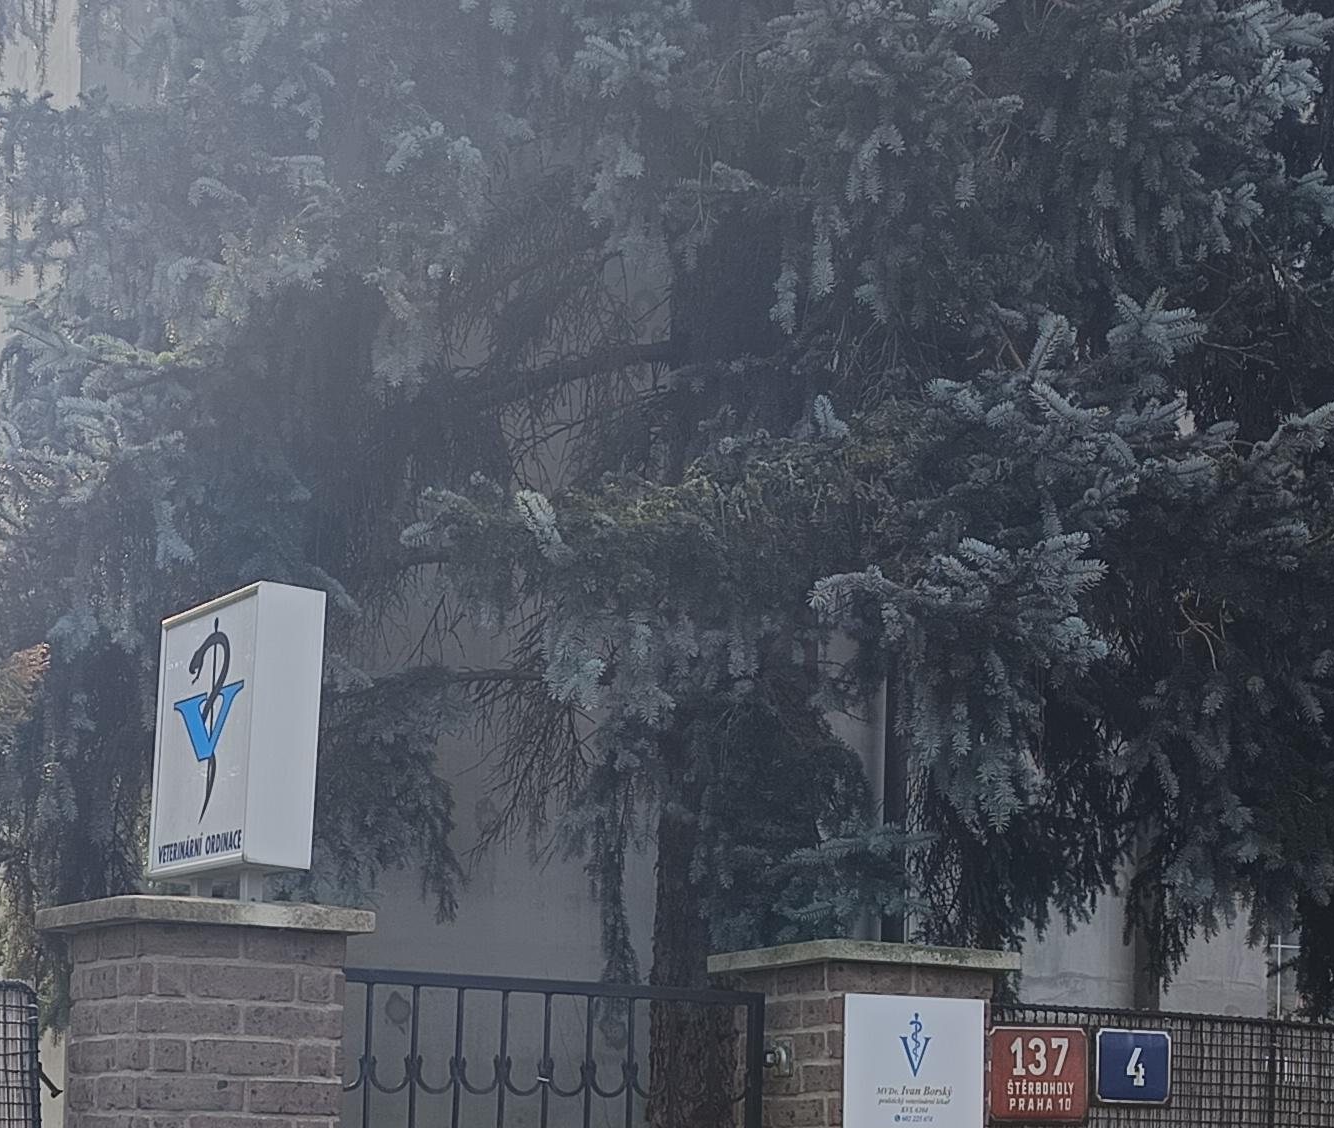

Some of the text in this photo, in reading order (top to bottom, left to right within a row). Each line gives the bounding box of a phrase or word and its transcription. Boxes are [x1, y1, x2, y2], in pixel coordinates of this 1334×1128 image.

[158, 829, 242, 864] VETERINÁRNÍ ORDINACE
[1010, 1037, 1069, 1076] 137
[1126, 1047, 1145, 1086] 4
[901, 1085, 921, 1095] Ivan
[923, 1086, 952, 1098] Borský
[1007, 1079, 1075, 1095] ŠTĚRBOHOLY
[1009, 1098, 1072, 1111] PRAHA 10
